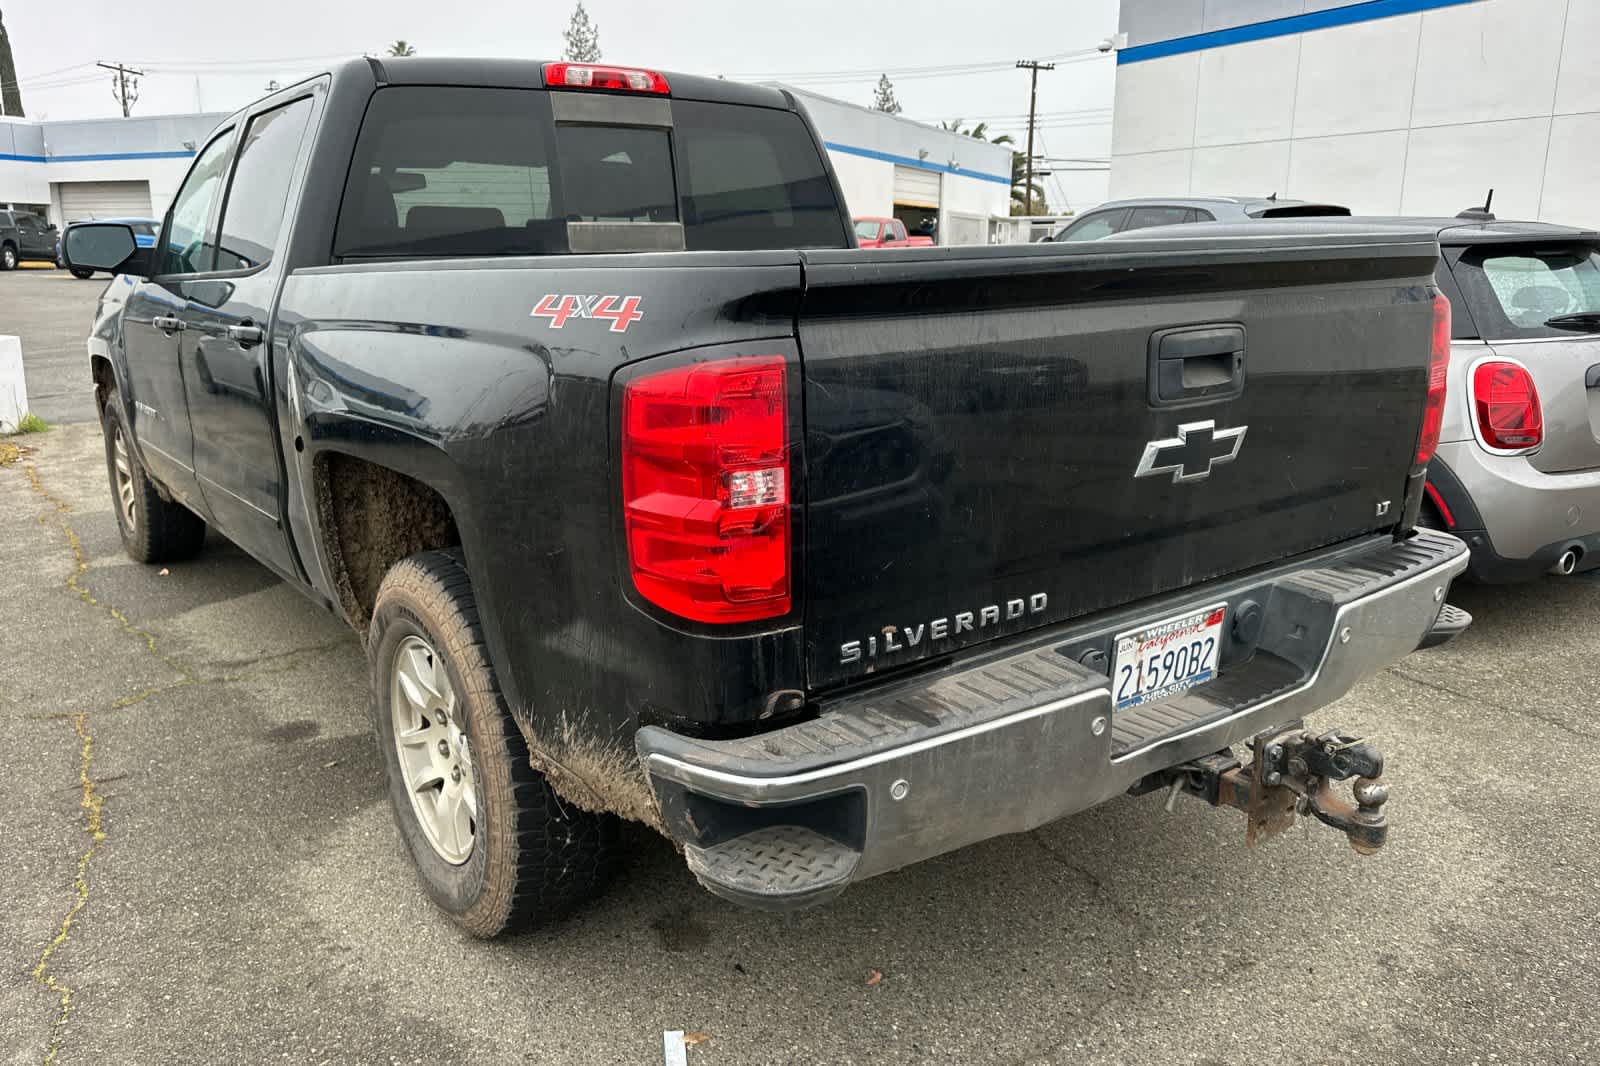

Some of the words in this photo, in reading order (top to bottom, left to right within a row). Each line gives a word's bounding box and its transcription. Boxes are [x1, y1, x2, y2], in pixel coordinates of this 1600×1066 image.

[1376, 500, 1391, 516] LT
[840, 592, 1048, 664] SILVERADO
[1146, 613, 1204, 639] WHEELER
[1119, 641, 1134, 654] JUN
[1116, 636, 1216, 702] 21590B2
